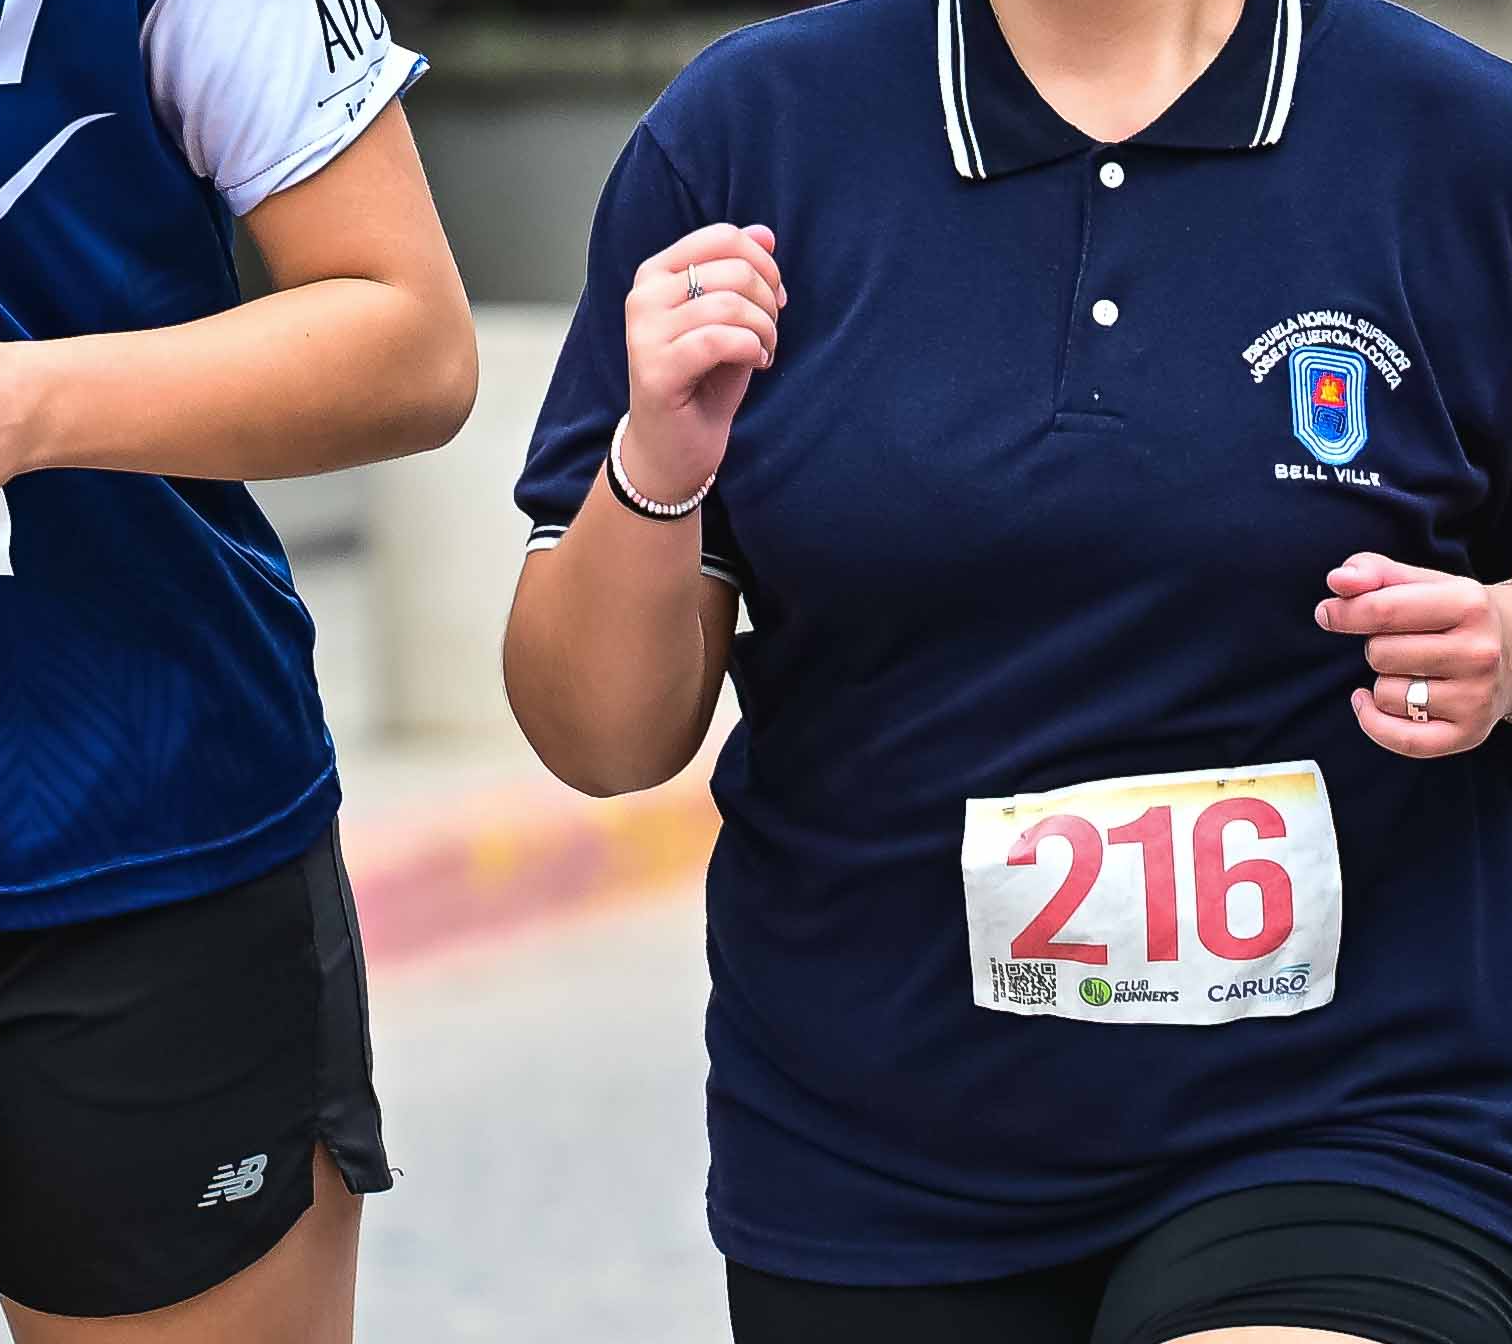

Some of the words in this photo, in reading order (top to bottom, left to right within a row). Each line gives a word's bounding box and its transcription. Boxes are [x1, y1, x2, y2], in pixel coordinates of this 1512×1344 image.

[1242, 318, 1298, 364] ESCUELA
[1296, 310, 1357, 330] NORMAL
[1355, 318, 1412, 372] SUPERIOR
[1250, 348, 1283, 384] JOSE
[1279, 329, 1351, 356] FIGUEROA
[1350, 336, 1403, 391] ALCORTA
[1274, 463, 1328, 481] BELL
[1334, 466, 1381, 487] VILLE
[1006, 796, 1295, 966] 216
[1115, 978, 1149, 992] CLUB
[1207, 974, 1307, 1003] CARUSO
